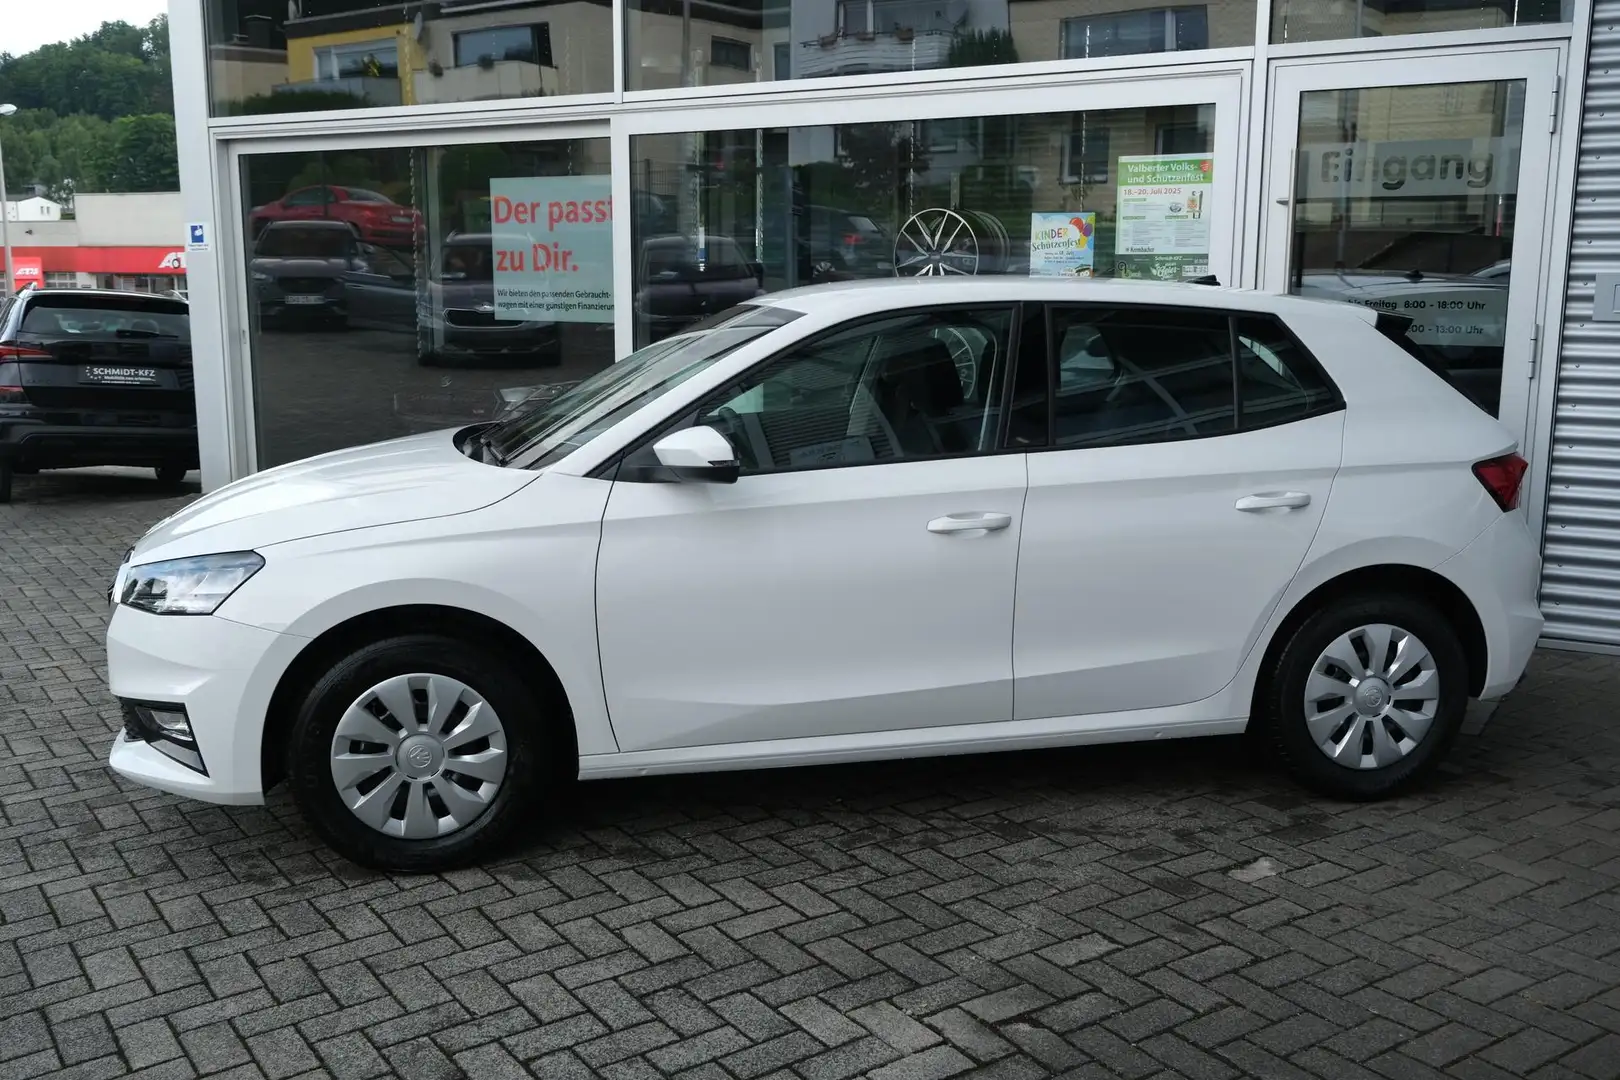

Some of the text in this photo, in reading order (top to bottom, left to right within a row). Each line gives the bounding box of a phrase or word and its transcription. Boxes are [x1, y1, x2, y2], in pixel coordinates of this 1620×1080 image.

[1170, 162, 1198, 171] Volks-
[1320, 147, 1494, 190] Eingang
[1127, 174, 1145, 183] und
[1163, 187, 1182, 195] 2025
[494, 195, 540, 224] Der
[1035, 227, 1068, 241] KINDER
[496, 242, 579, 272] zu Dir.
[497, 289, 611, 300] Wir bieten den passenden Gebraucht-
[497, 302, 517, 310] wagen
[1364, 299, 1398, 310] Freitag
[1404, 300, 1426, 309] 8:00
[1437, 301, 1463, 310] 18:00
[1467, 301, 1486, 310] Uhr
[1436, 325, 1461, 334] 13:00
[1465, 325, 1484, 334] Uhr
[93, 367, 156, 377] SCHMIDT-KFZ
